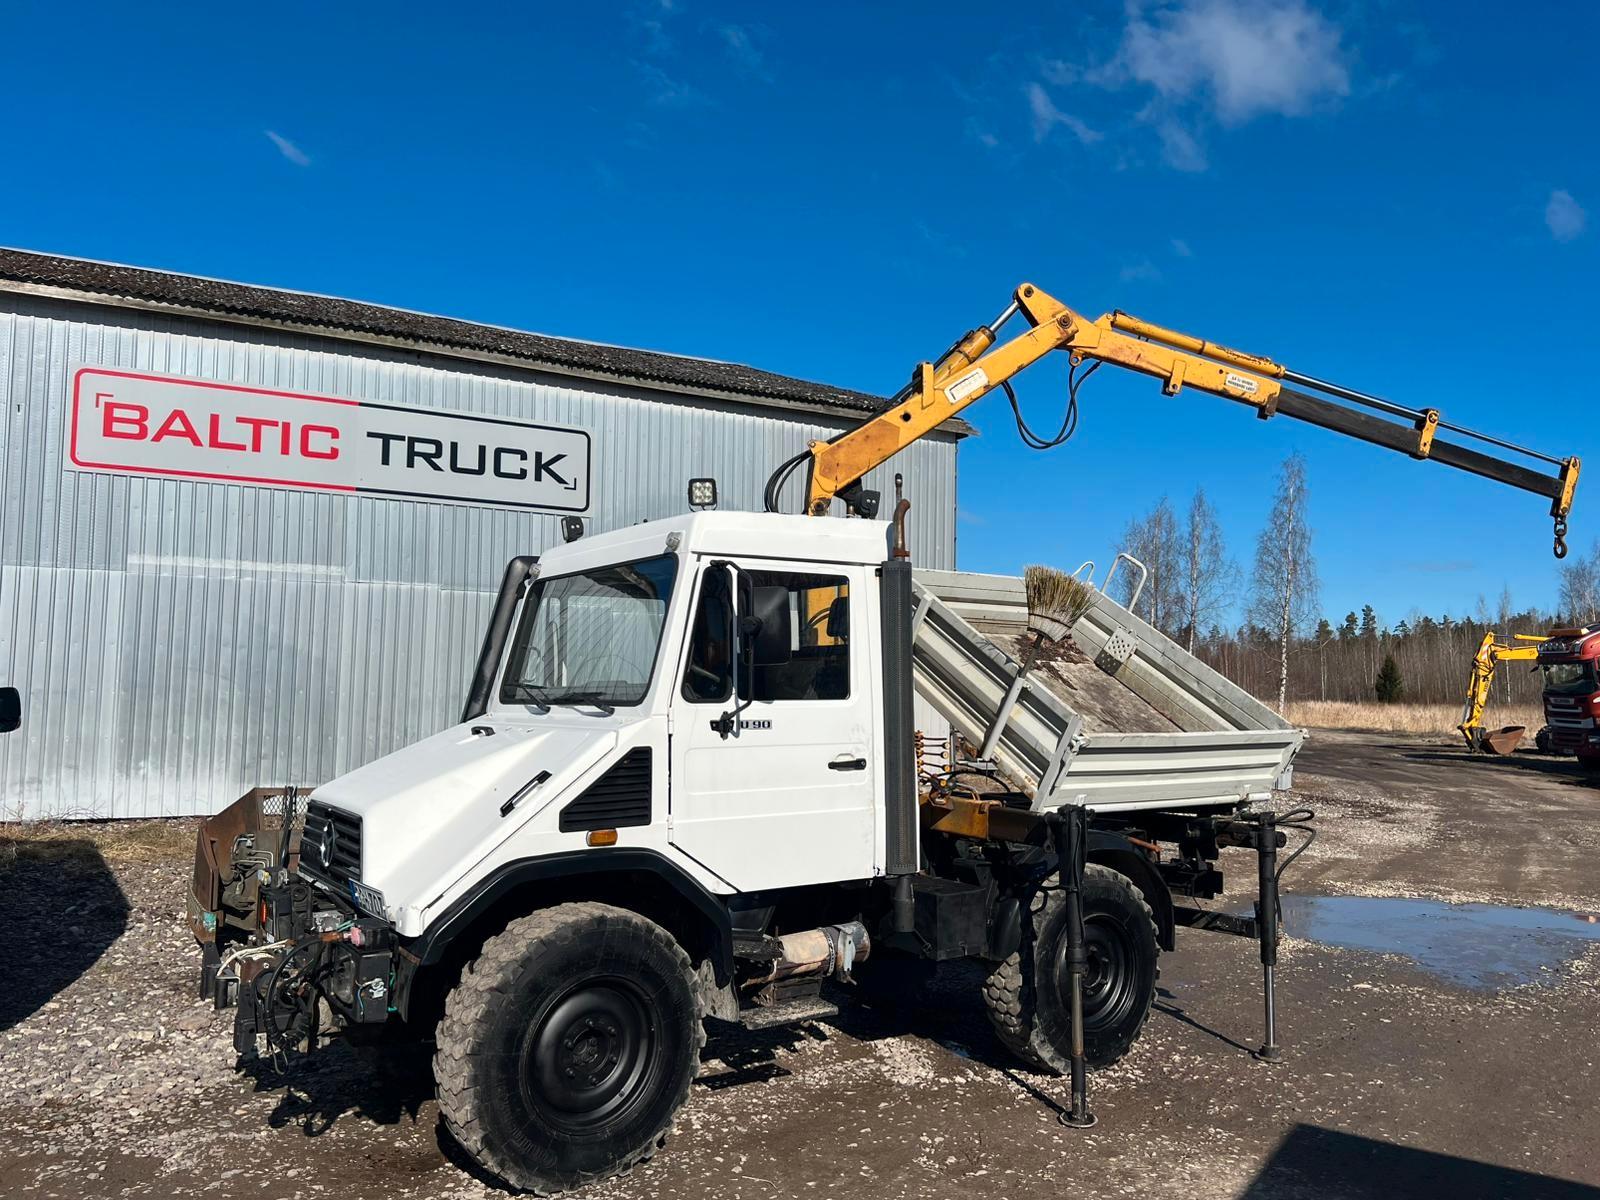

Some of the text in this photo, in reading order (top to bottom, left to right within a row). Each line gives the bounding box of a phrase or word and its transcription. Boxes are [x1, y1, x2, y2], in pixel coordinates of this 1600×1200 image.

[102, 402, 569, 485] BALTIC TRUCK
[753, 720, 771, 729] 90
